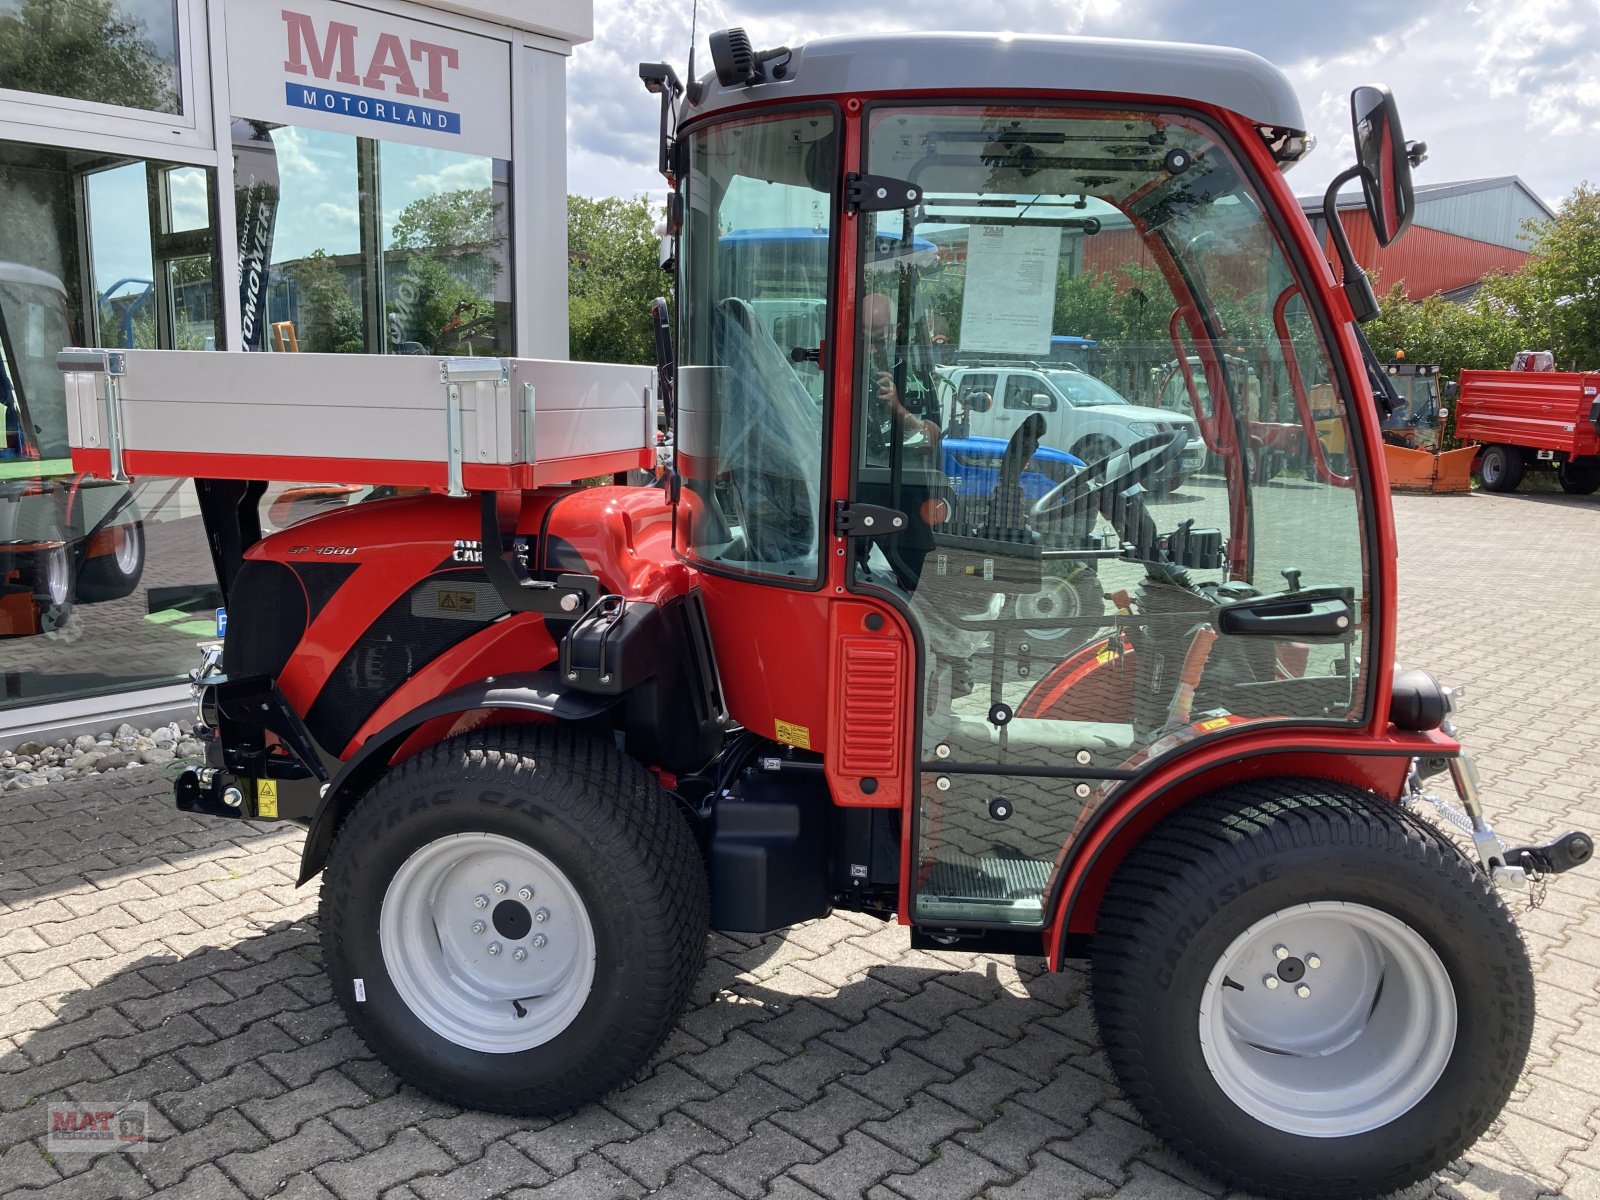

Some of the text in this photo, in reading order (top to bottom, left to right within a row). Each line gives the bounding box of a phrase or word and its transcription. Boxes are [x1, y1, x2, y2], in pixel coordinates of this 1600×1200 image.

[281, 9, 459, 103] MAT
[303, 90, 448, 128] MOTORLAND
[368, 789, 455, 841] TRAC
[1155, 863, 1280, 991] CARLISLE
[1490, 964, 1516, 1086] MULTI
